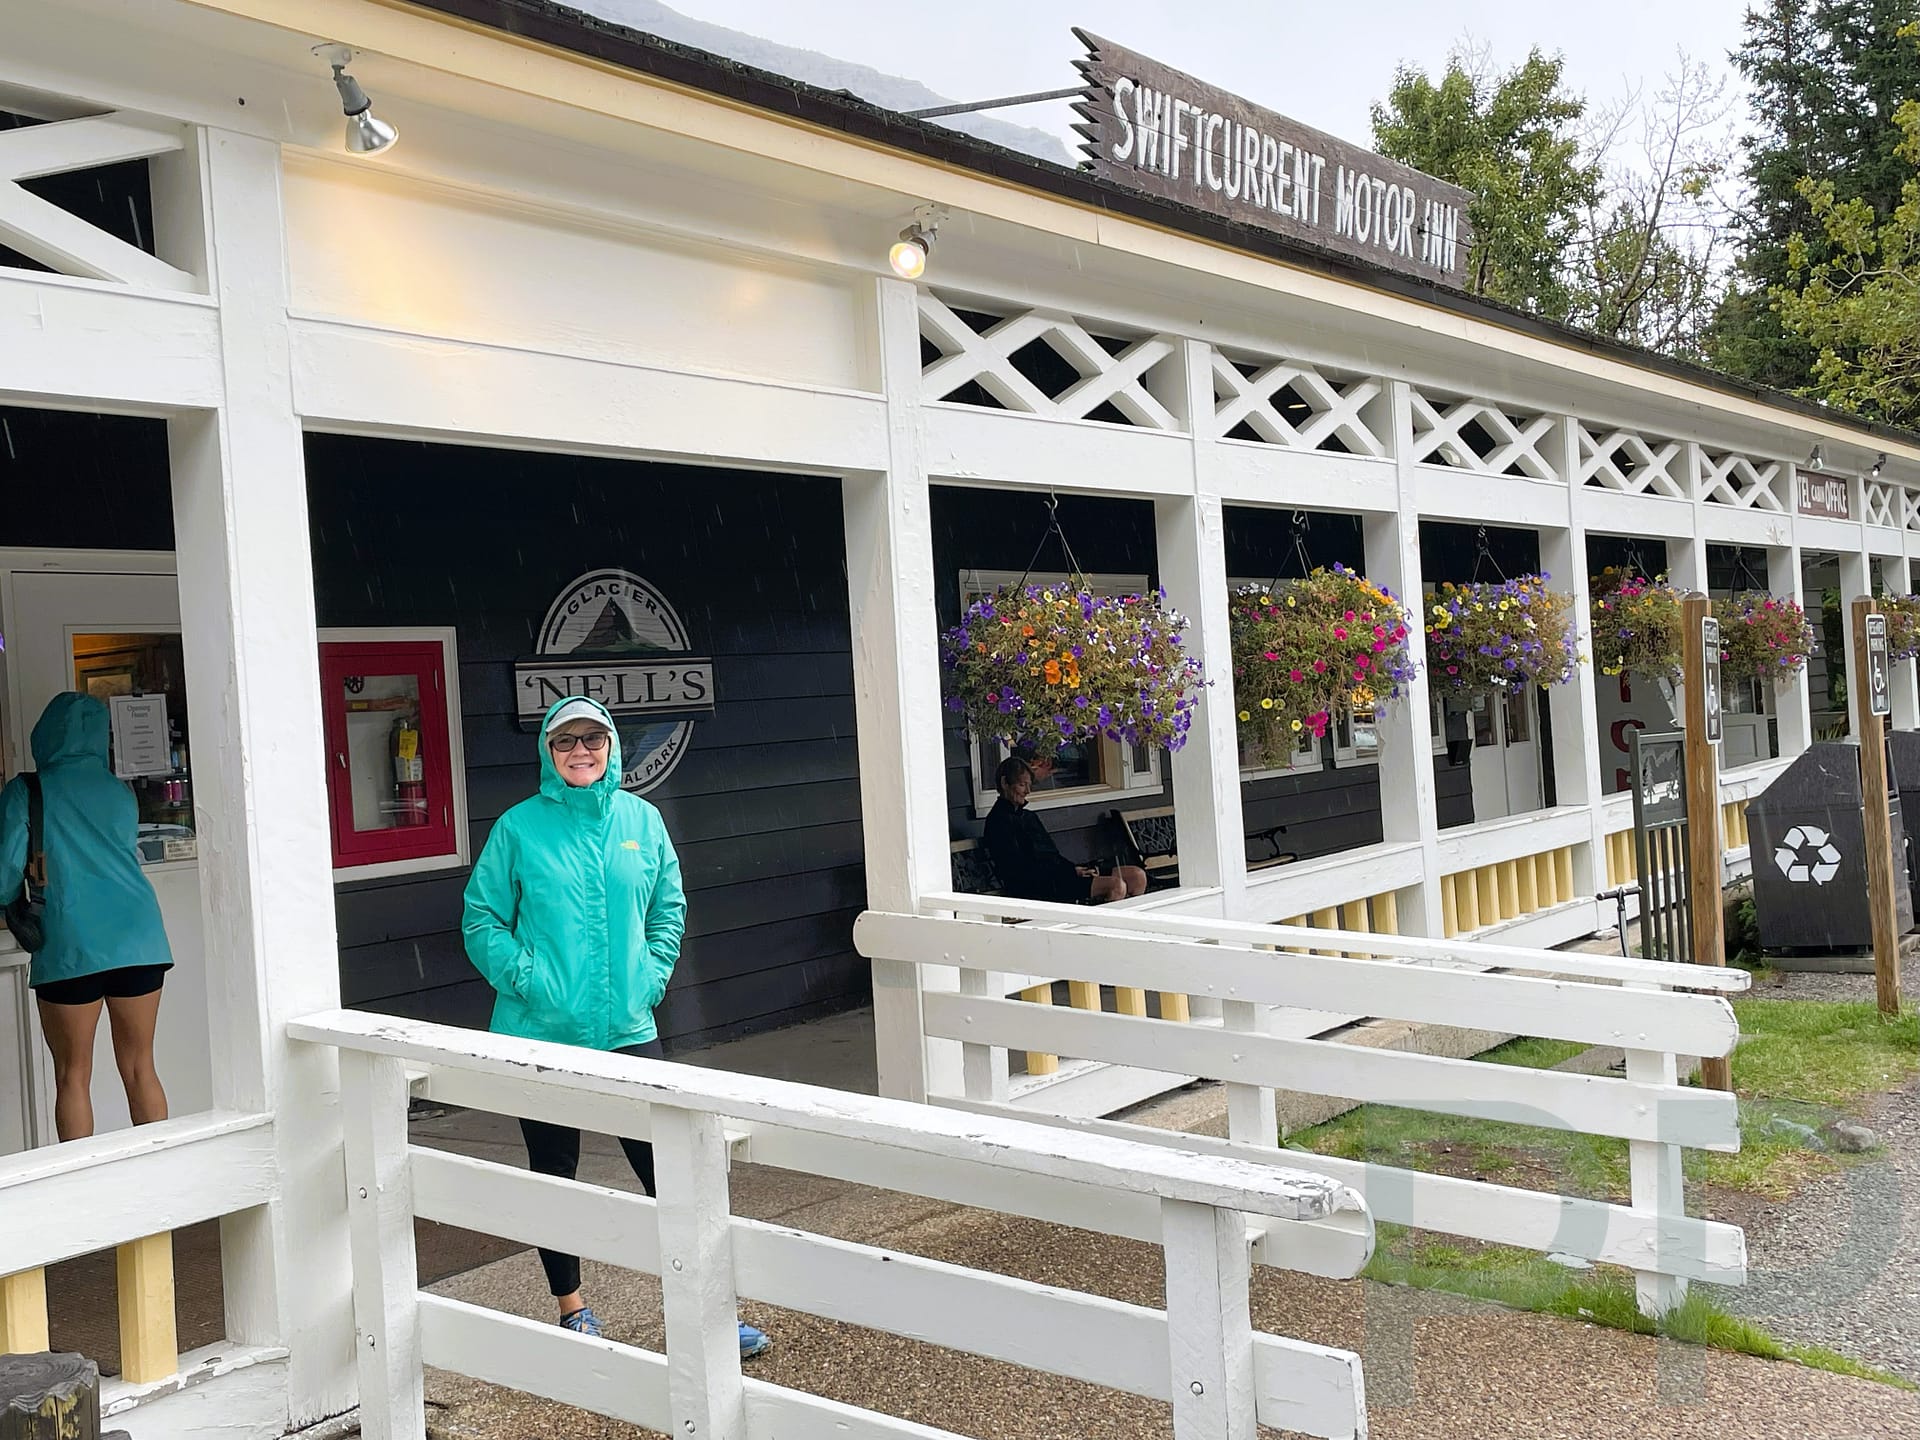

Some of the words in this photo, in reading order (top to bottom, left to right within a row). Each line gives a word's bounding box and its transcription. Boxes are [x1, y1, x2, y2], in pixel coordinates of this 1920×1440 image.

[1111, 76, 1326, 226] SWIFTCURRENT
[1335, 164, 1416, 259] MOTOR
[1420, 199, 1459, 274] INN
[1824, 480, 1848, 514] OFFICE
[567, 583, 658, 616] GLACIER
[624, 772, 643, 785] AL
[645, 738, 677, 776] PARK
